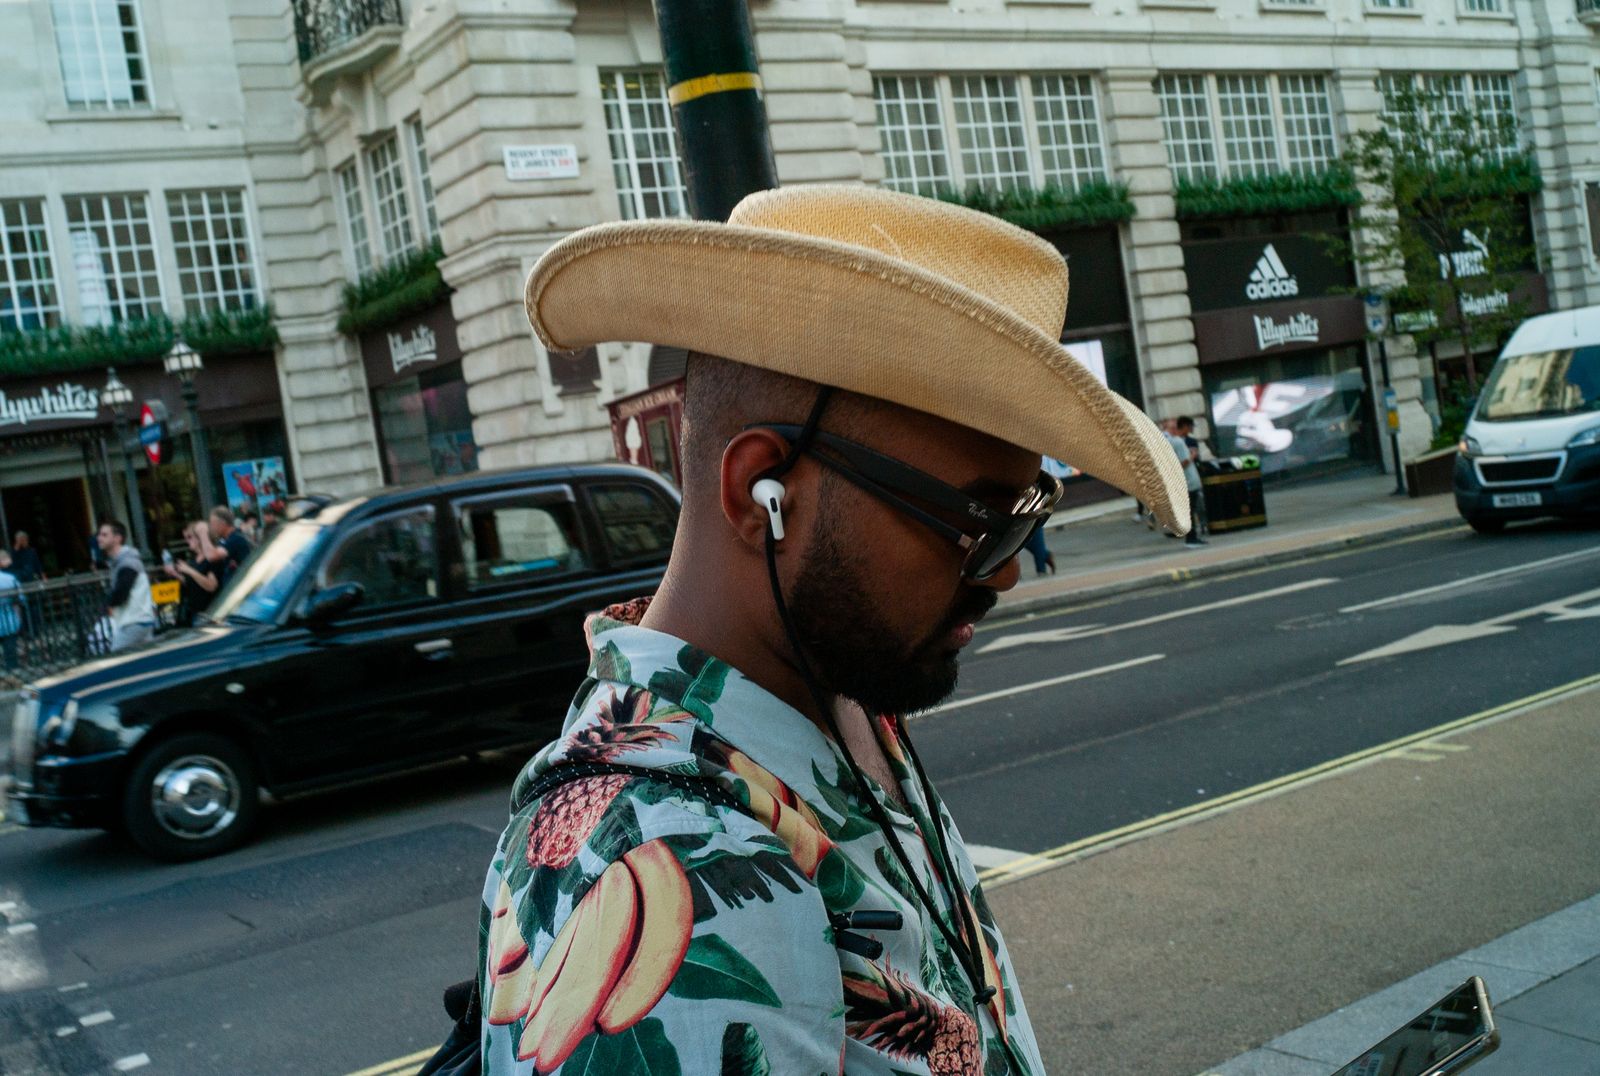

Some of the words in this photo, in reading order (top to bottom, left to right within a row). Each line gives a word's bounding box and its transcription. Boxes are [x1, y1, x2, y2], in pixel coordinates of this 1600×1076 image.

[509, 150, 538, 158] REGENT
[542, 149, 568, 157] STREET
[1246, 278, 1298, 300] adidas
[1253, 311, 1319, 350] Lillywhites
